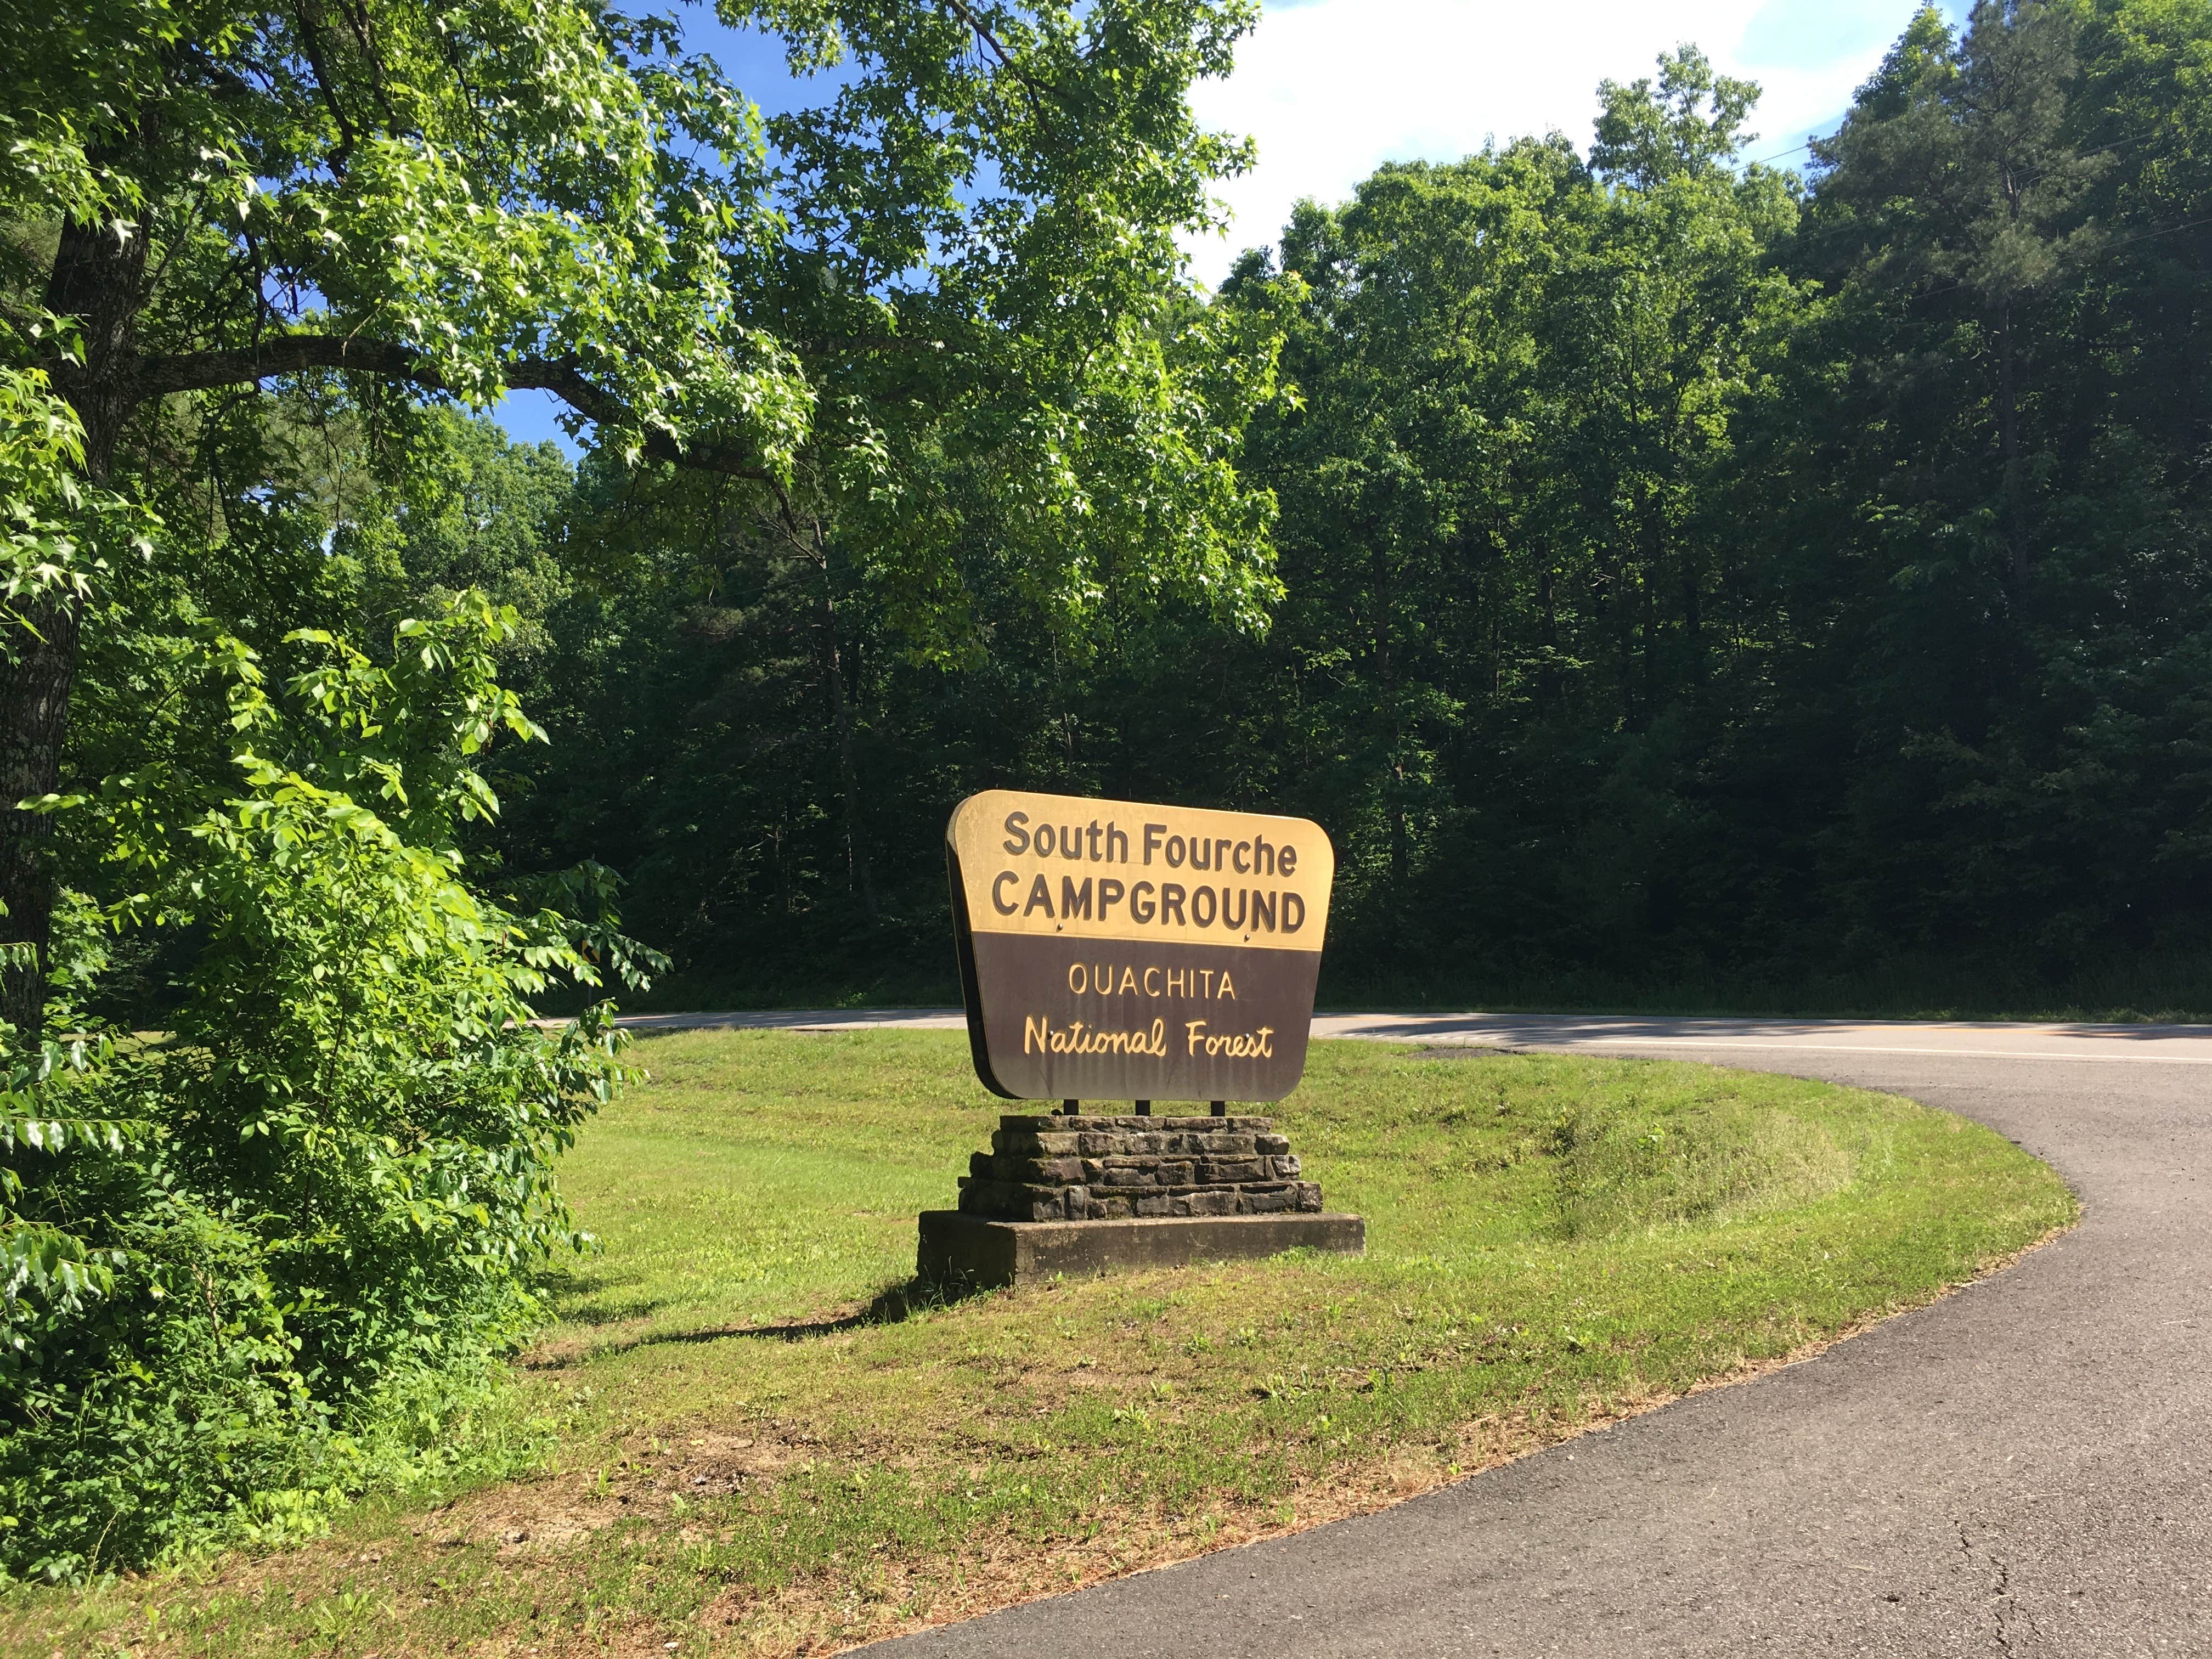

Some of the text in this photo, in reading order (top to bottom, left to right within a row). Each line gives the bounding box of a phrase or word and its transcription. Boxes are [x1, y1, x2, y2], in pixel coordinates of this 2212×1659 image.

[1003, 811, 1297, 877] South Fourche
[992, 870, 1305, 933] CAMPGROUND
[1069, 962, 1236, 1000] OUACHITA
[1024, 1015, 1274, 1058] National Forest
